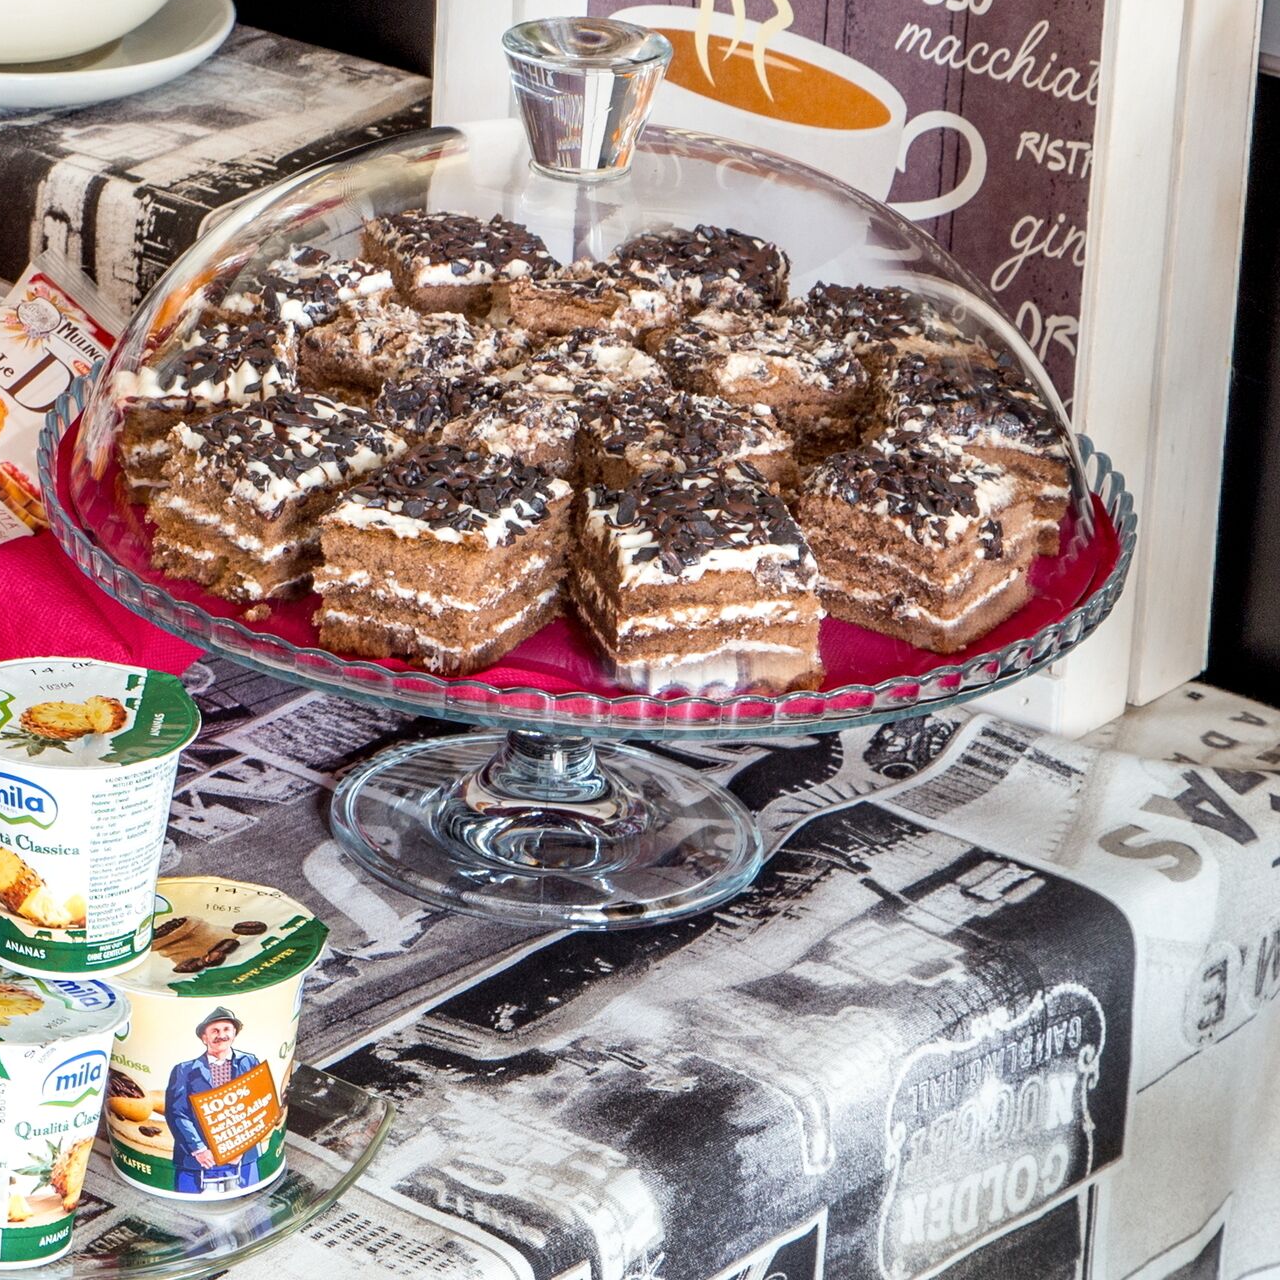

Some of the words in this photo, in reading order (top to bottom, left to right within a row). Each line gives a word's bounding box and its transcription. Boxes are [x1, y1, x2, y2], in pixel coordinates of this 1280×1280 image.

[15, 833, 81, 857] Classica
[5, 939, 47, 960] ANANAS
[55, 1062, 102, 1092] mila
[200, 1086, 251, 1116] 100%
[907, 1068, 959, 1116] HALL
[204, 1102, 246, 1126] Latte
[14, 1120, 70, 1142] Qualità
[212, 1120, 253, 1144] Milch
[216, 1119, 266, 1154] Südtirol
[122, 1156, 152, 1175] KAFFEE
[899, 1141, 1069, 1246] GOLDEN
[38, 1226, 70, 1247] ANANAS
